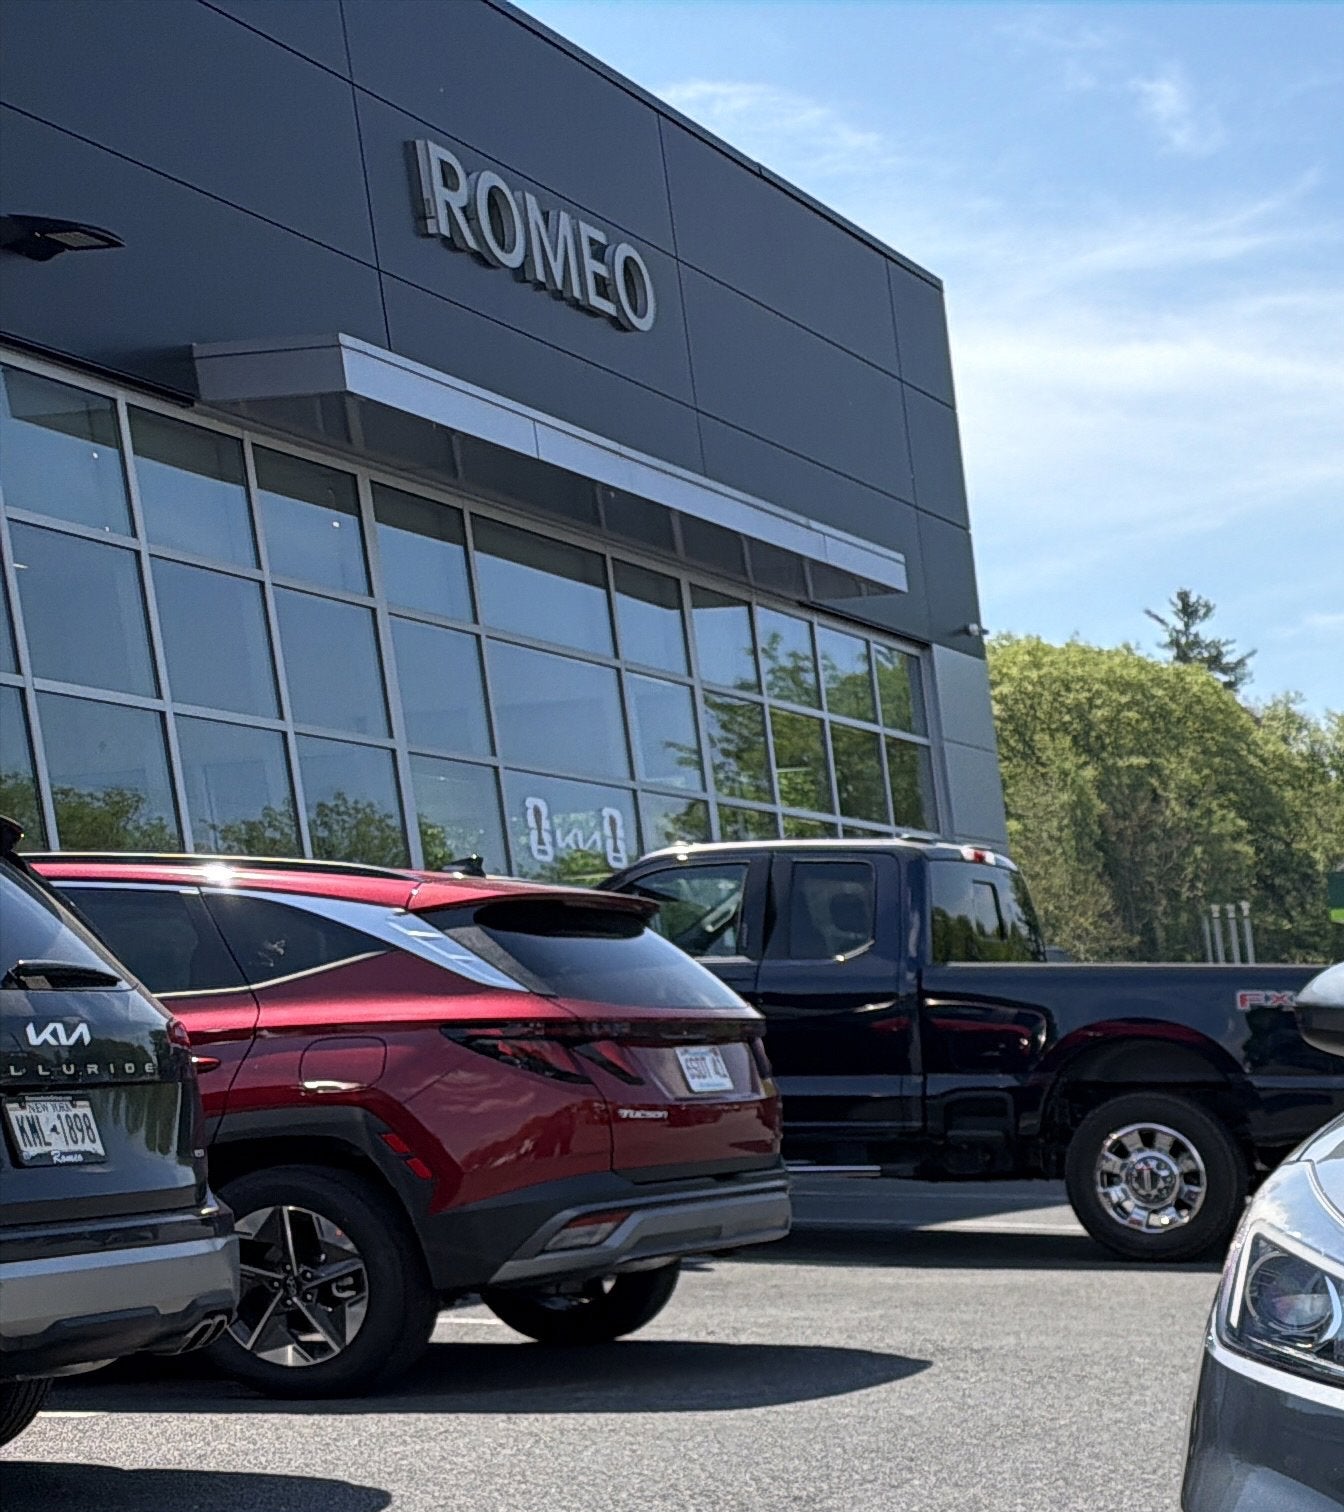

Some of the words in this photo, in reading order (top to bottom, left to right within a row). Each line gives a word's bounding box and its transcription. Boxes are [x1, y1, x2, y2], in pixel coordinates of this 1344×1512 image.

[410, 138, 656, 332] ROMEO
[1236, 990, 1298, 1011] FX
[57, 1112, 97, 1146] 1898
